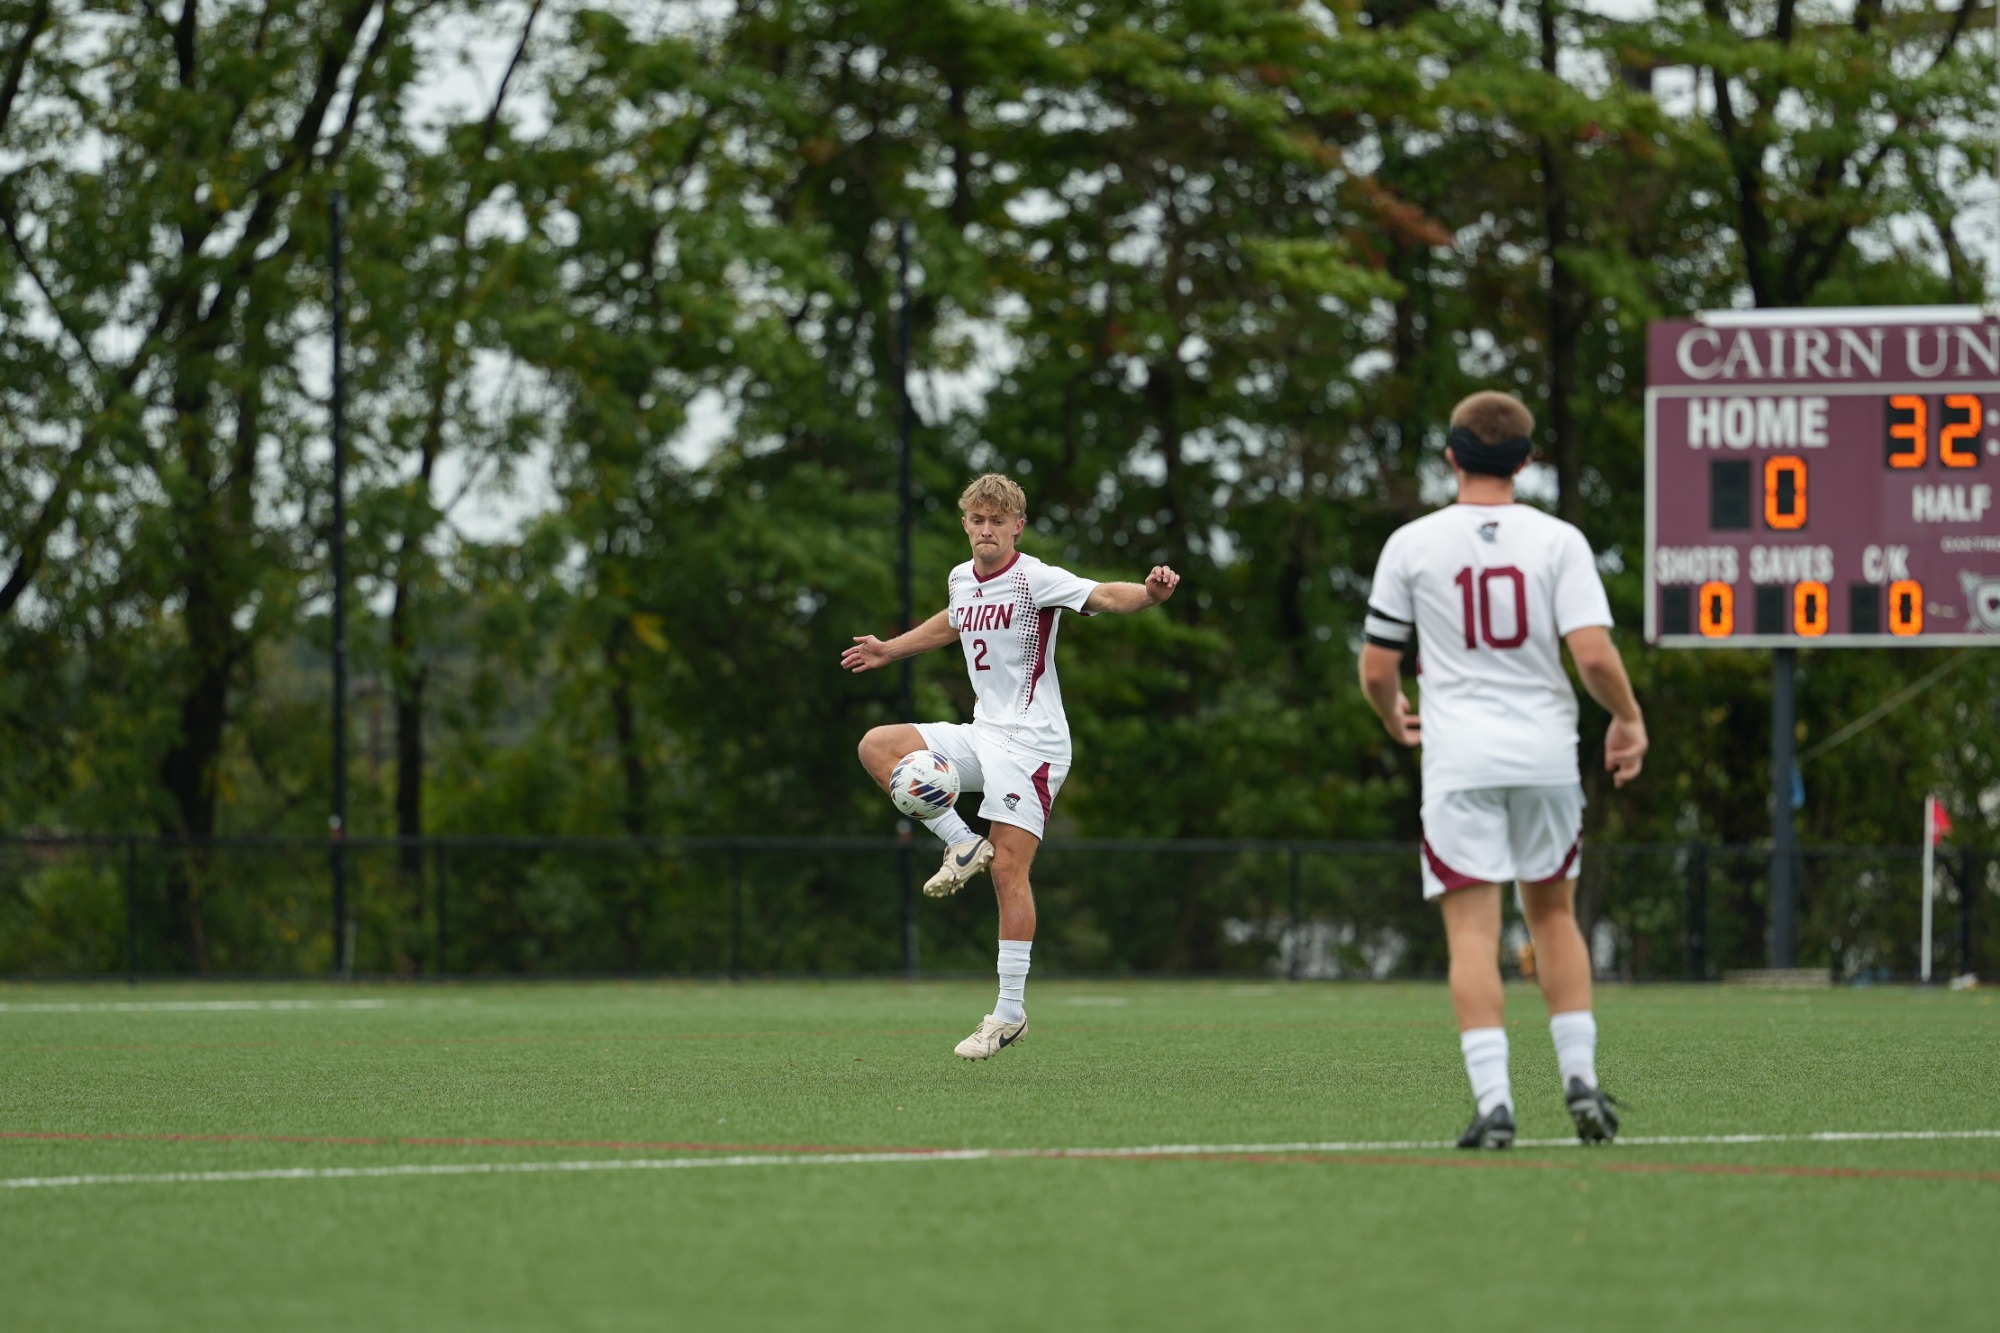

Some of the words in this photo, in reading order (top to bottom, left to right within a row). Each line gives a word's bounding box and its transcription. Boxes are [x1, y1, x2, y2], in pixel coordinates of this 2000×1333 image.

[1676, 327, 1886, 379] CAIRN
[1687, 396, 1830, 449] HOME
[1764, 455, 1807, 530] 0
[1912, 484, 1992, 523] HALF
[1655, 545, 1740, 584] SHOTS
[1749, 545, 1834, 584] SAVES
[956, 603, 1014, 633] CAIRN
[1455, 565, 1528, 649] 10
[1699, 580, 1734, 638] 0
[1793, 580, 1829, 637] 0
[1888, 579, 1923, 636] 0
[972, 638, 991, 671] 2
